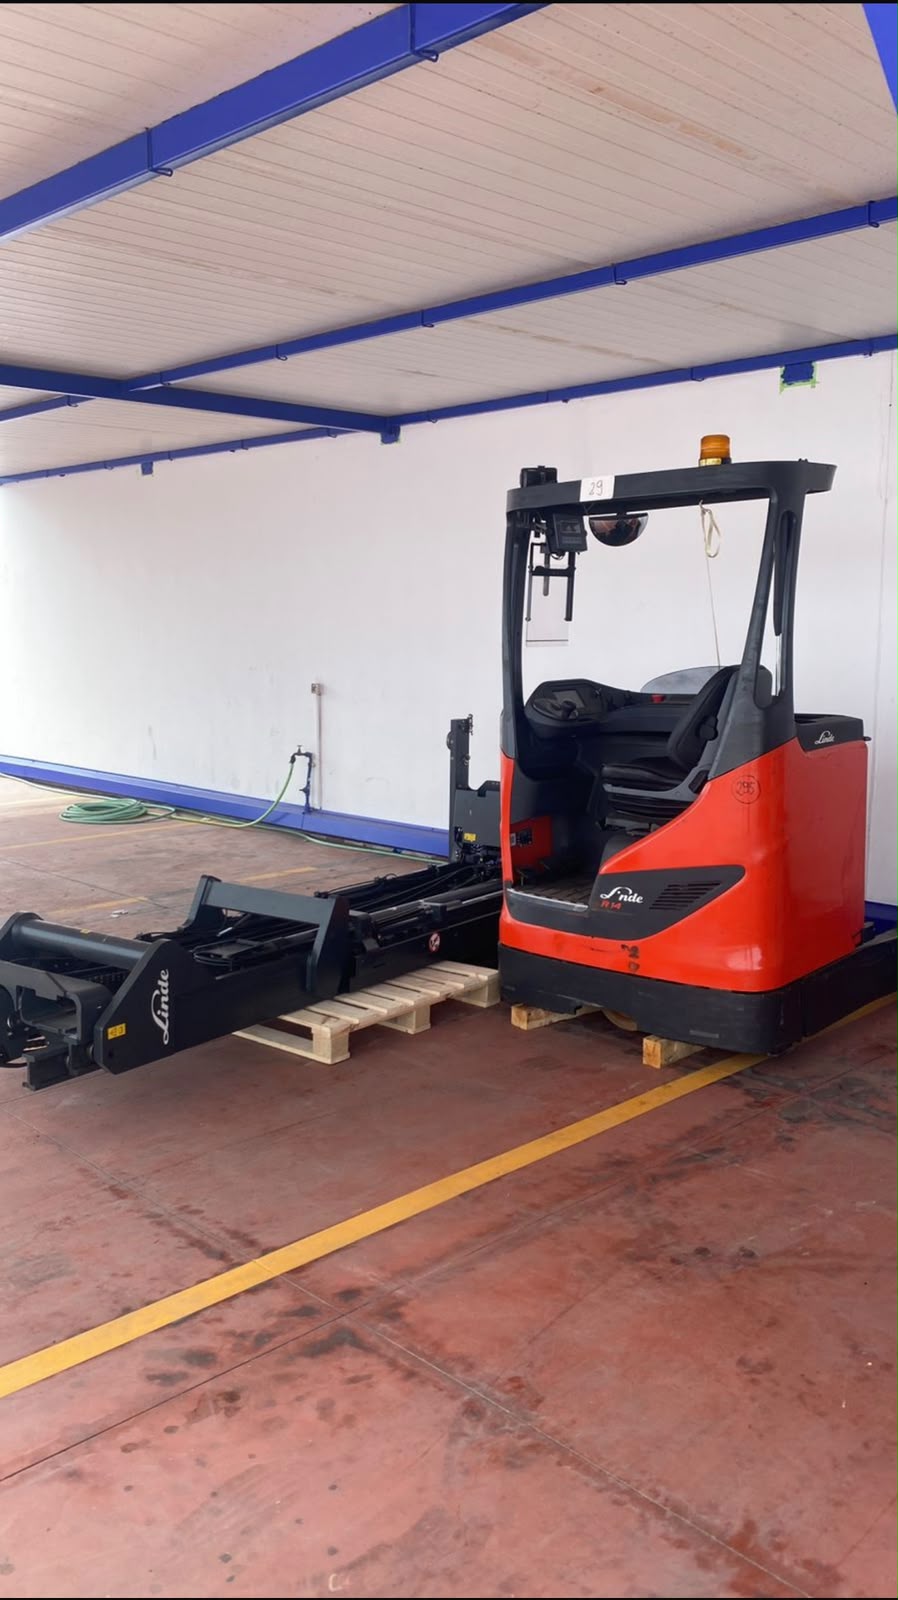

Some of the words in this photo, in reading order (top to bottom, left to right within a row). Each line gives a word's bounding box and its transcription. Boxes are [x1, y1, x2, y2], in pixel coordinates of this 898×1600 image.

[588, 480, 604, 497] 29
[814, 730, 835, 745] Linde
[599, 886, 644, 904] Lnde
[151, 968, 169, 1045] Linde
